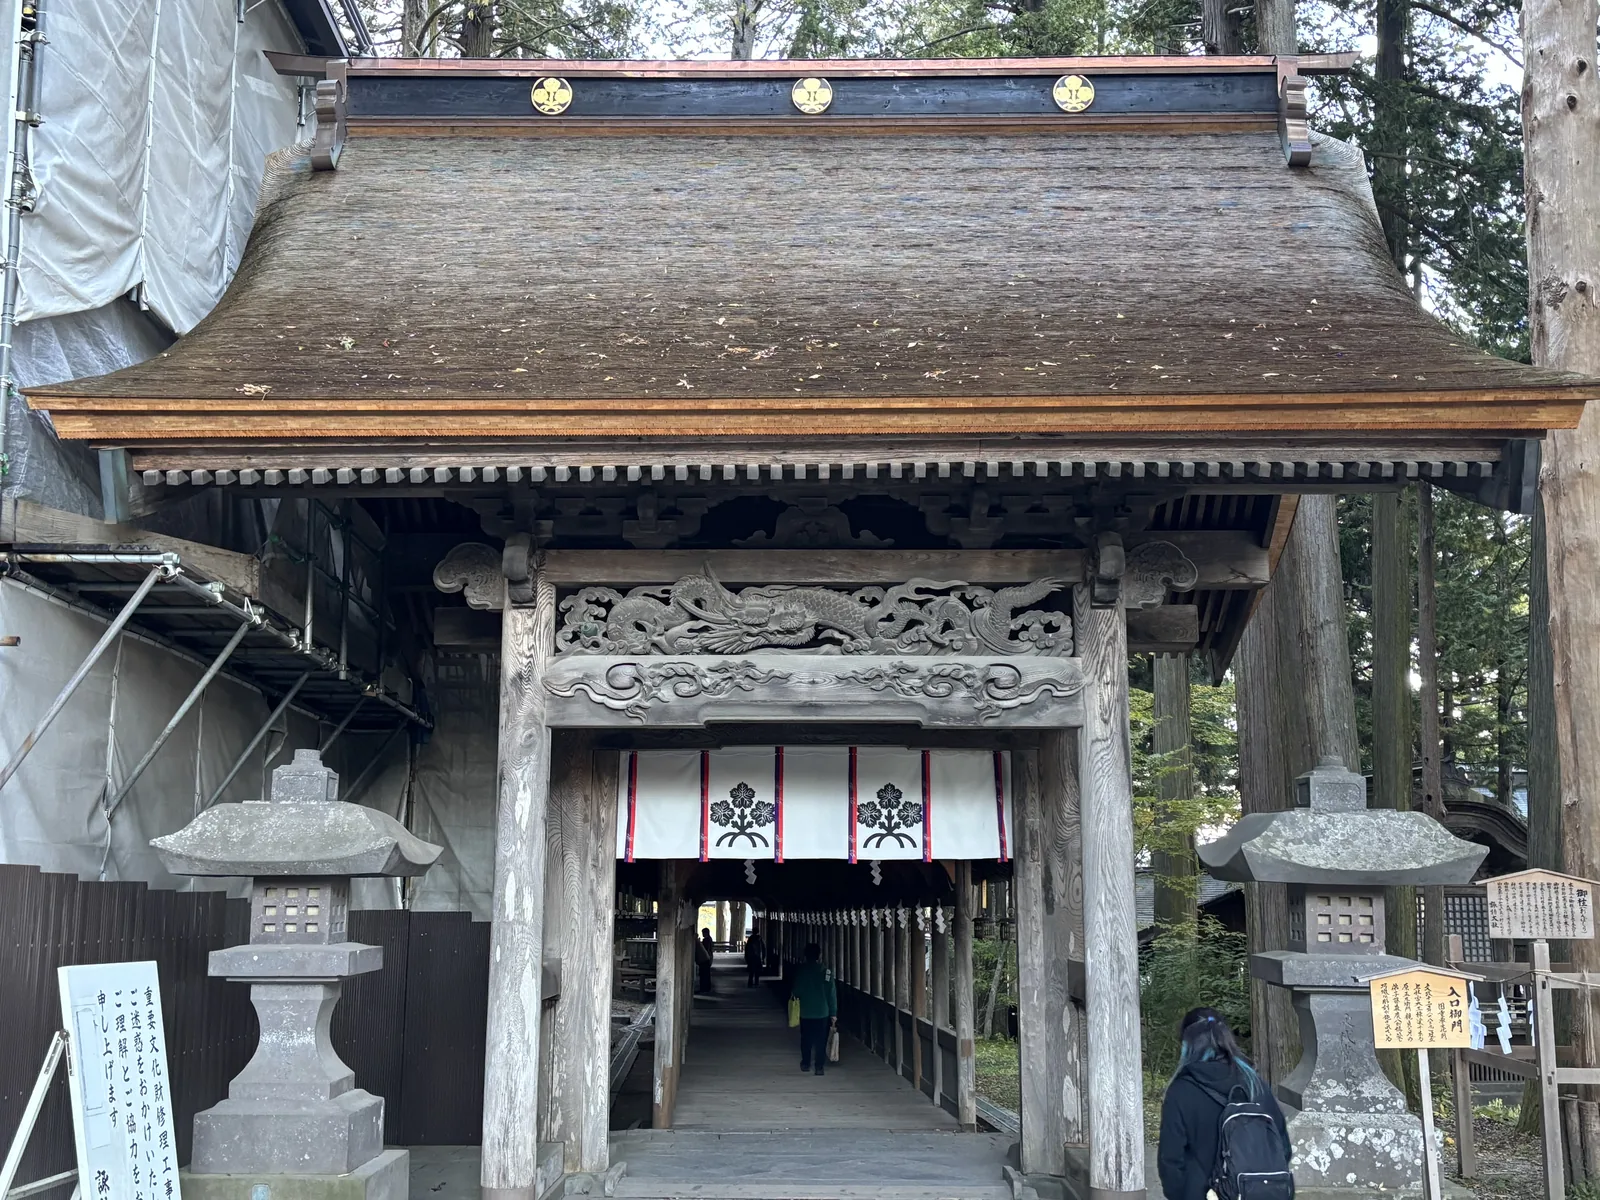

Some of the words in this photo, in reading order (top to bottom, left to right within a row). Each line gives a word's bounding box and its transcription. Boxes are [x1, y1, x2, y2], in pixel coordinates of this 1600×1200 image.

[1447, 986, 1463, 1033] 入口御門
[97, 990, 119, 1128] 申し上げます
[143, 986, 174, 1200] 重要文化財修理工事
[95, 1170, 110, 1200] 諏
